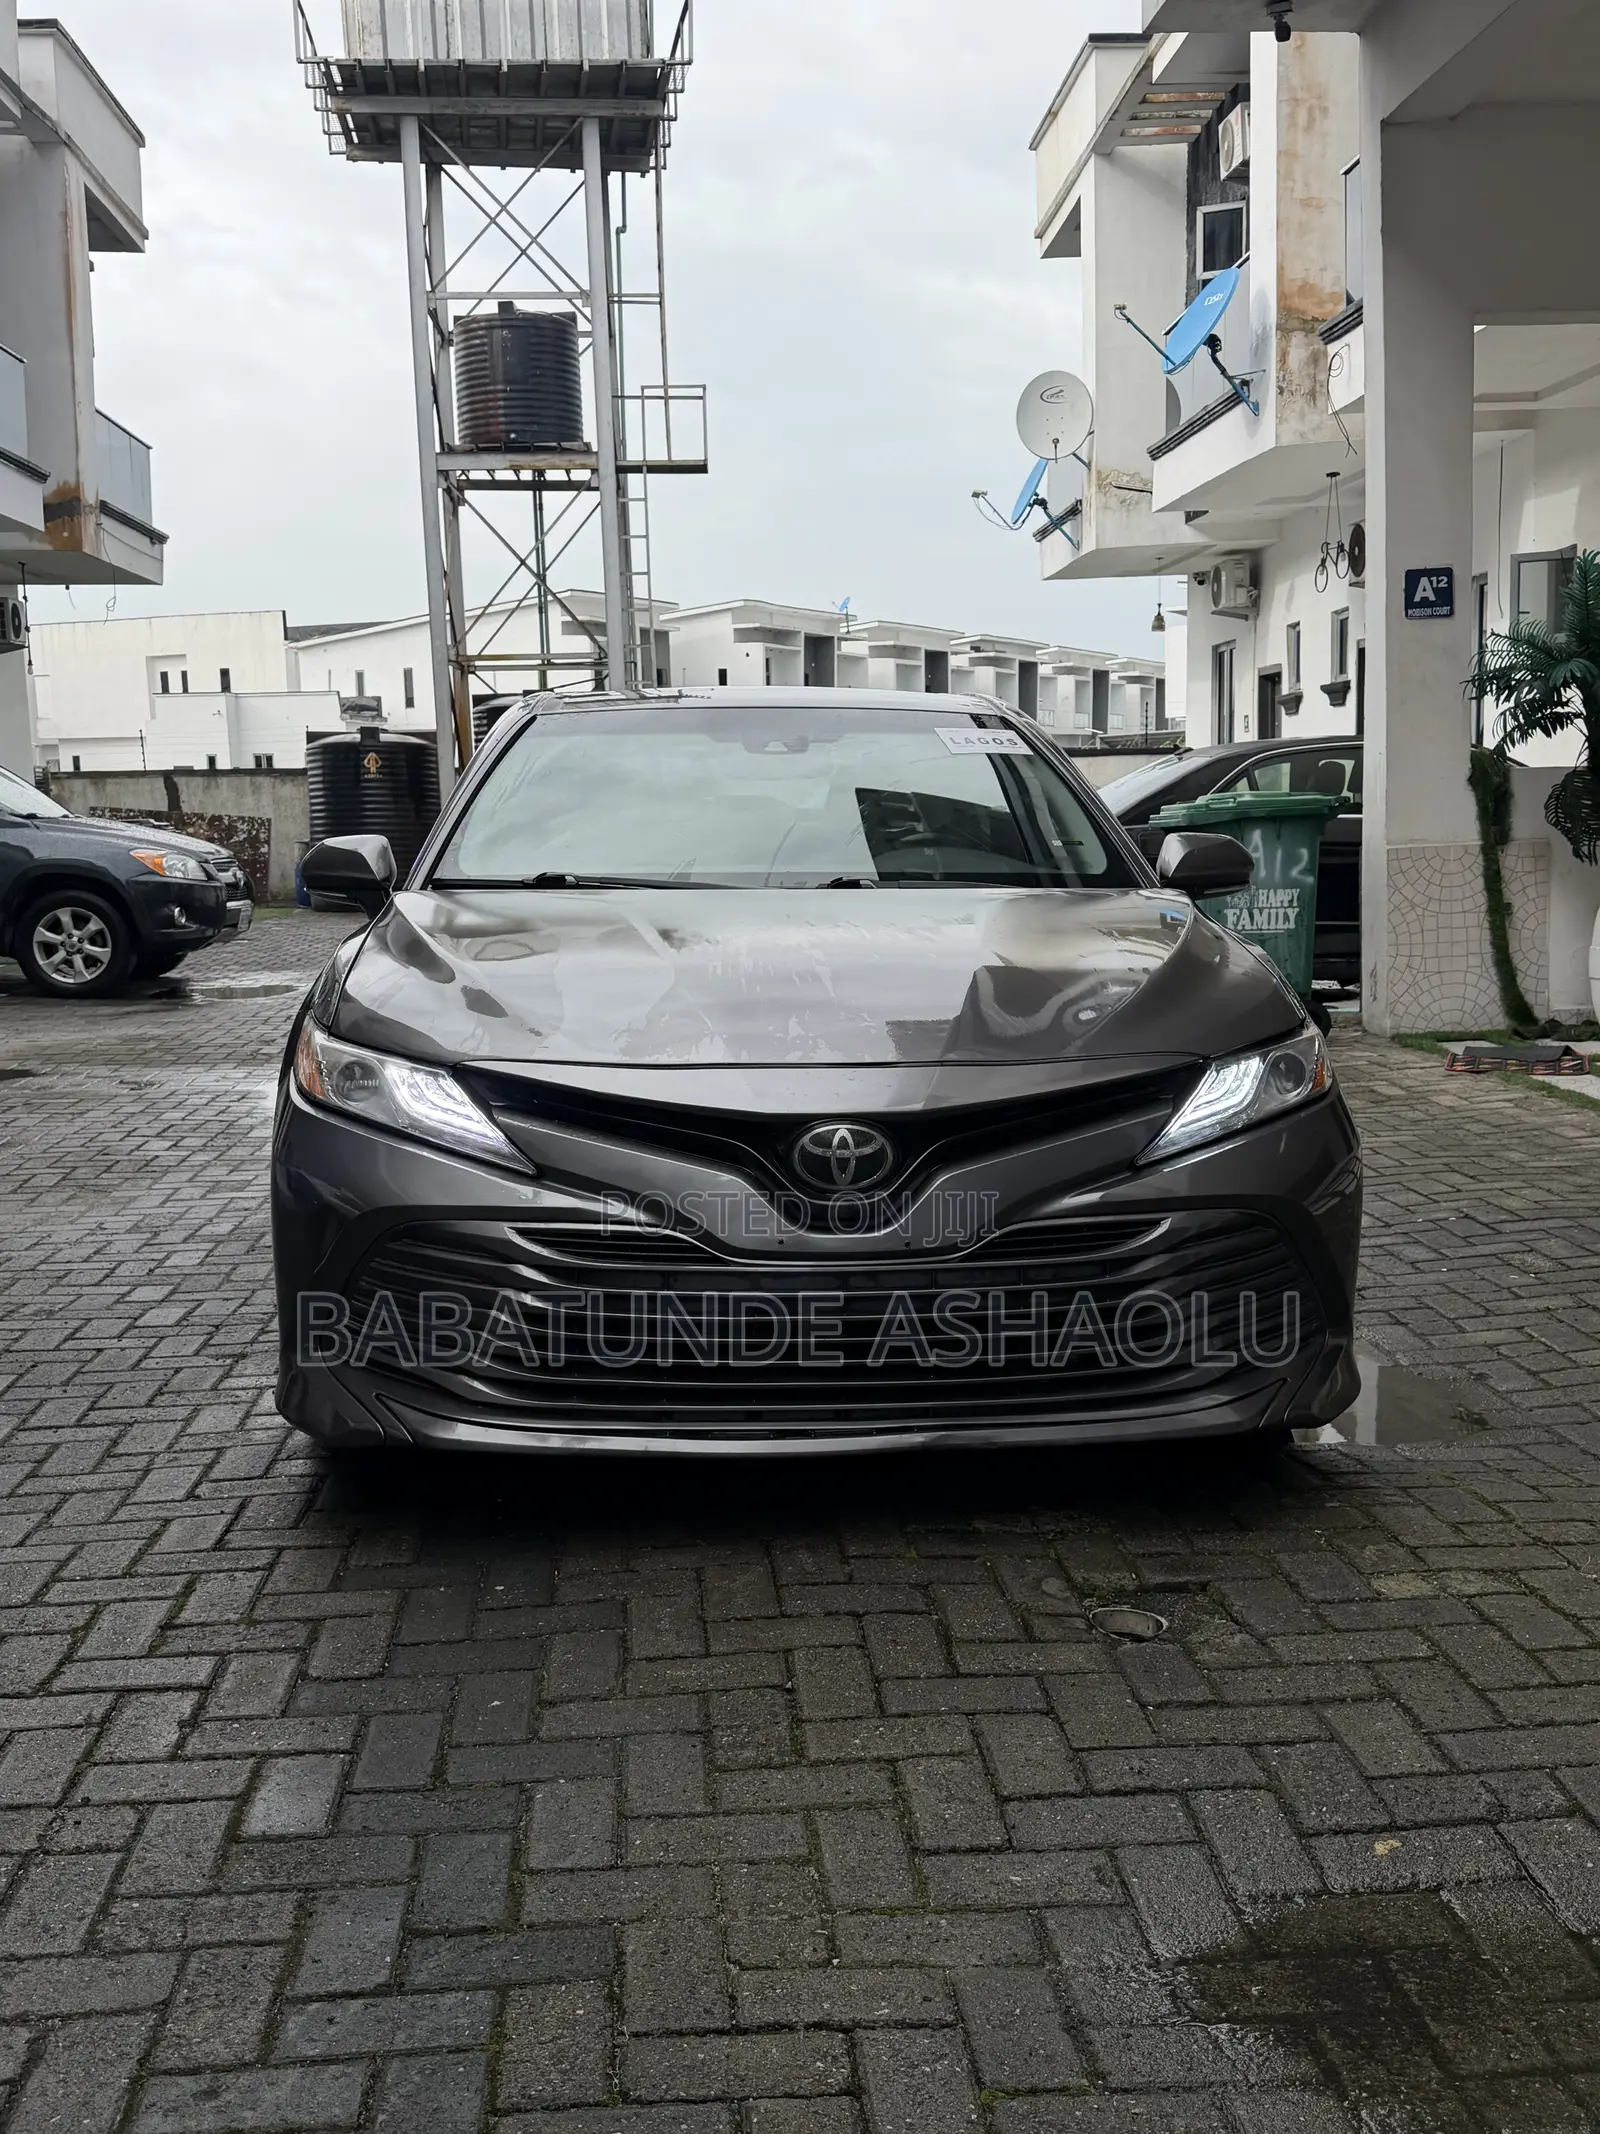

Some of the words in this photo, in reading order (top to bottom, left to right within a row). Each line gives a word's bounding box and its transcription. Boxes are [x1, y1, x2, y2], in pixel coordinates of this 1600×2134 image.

[1433, 606, 1451, 615] COURT
[949, 737, 1018, 746] LAGOS
[1258, 888, 1300, 908] HAPPY
[1224, 907, 1299, 930] FAMILY
